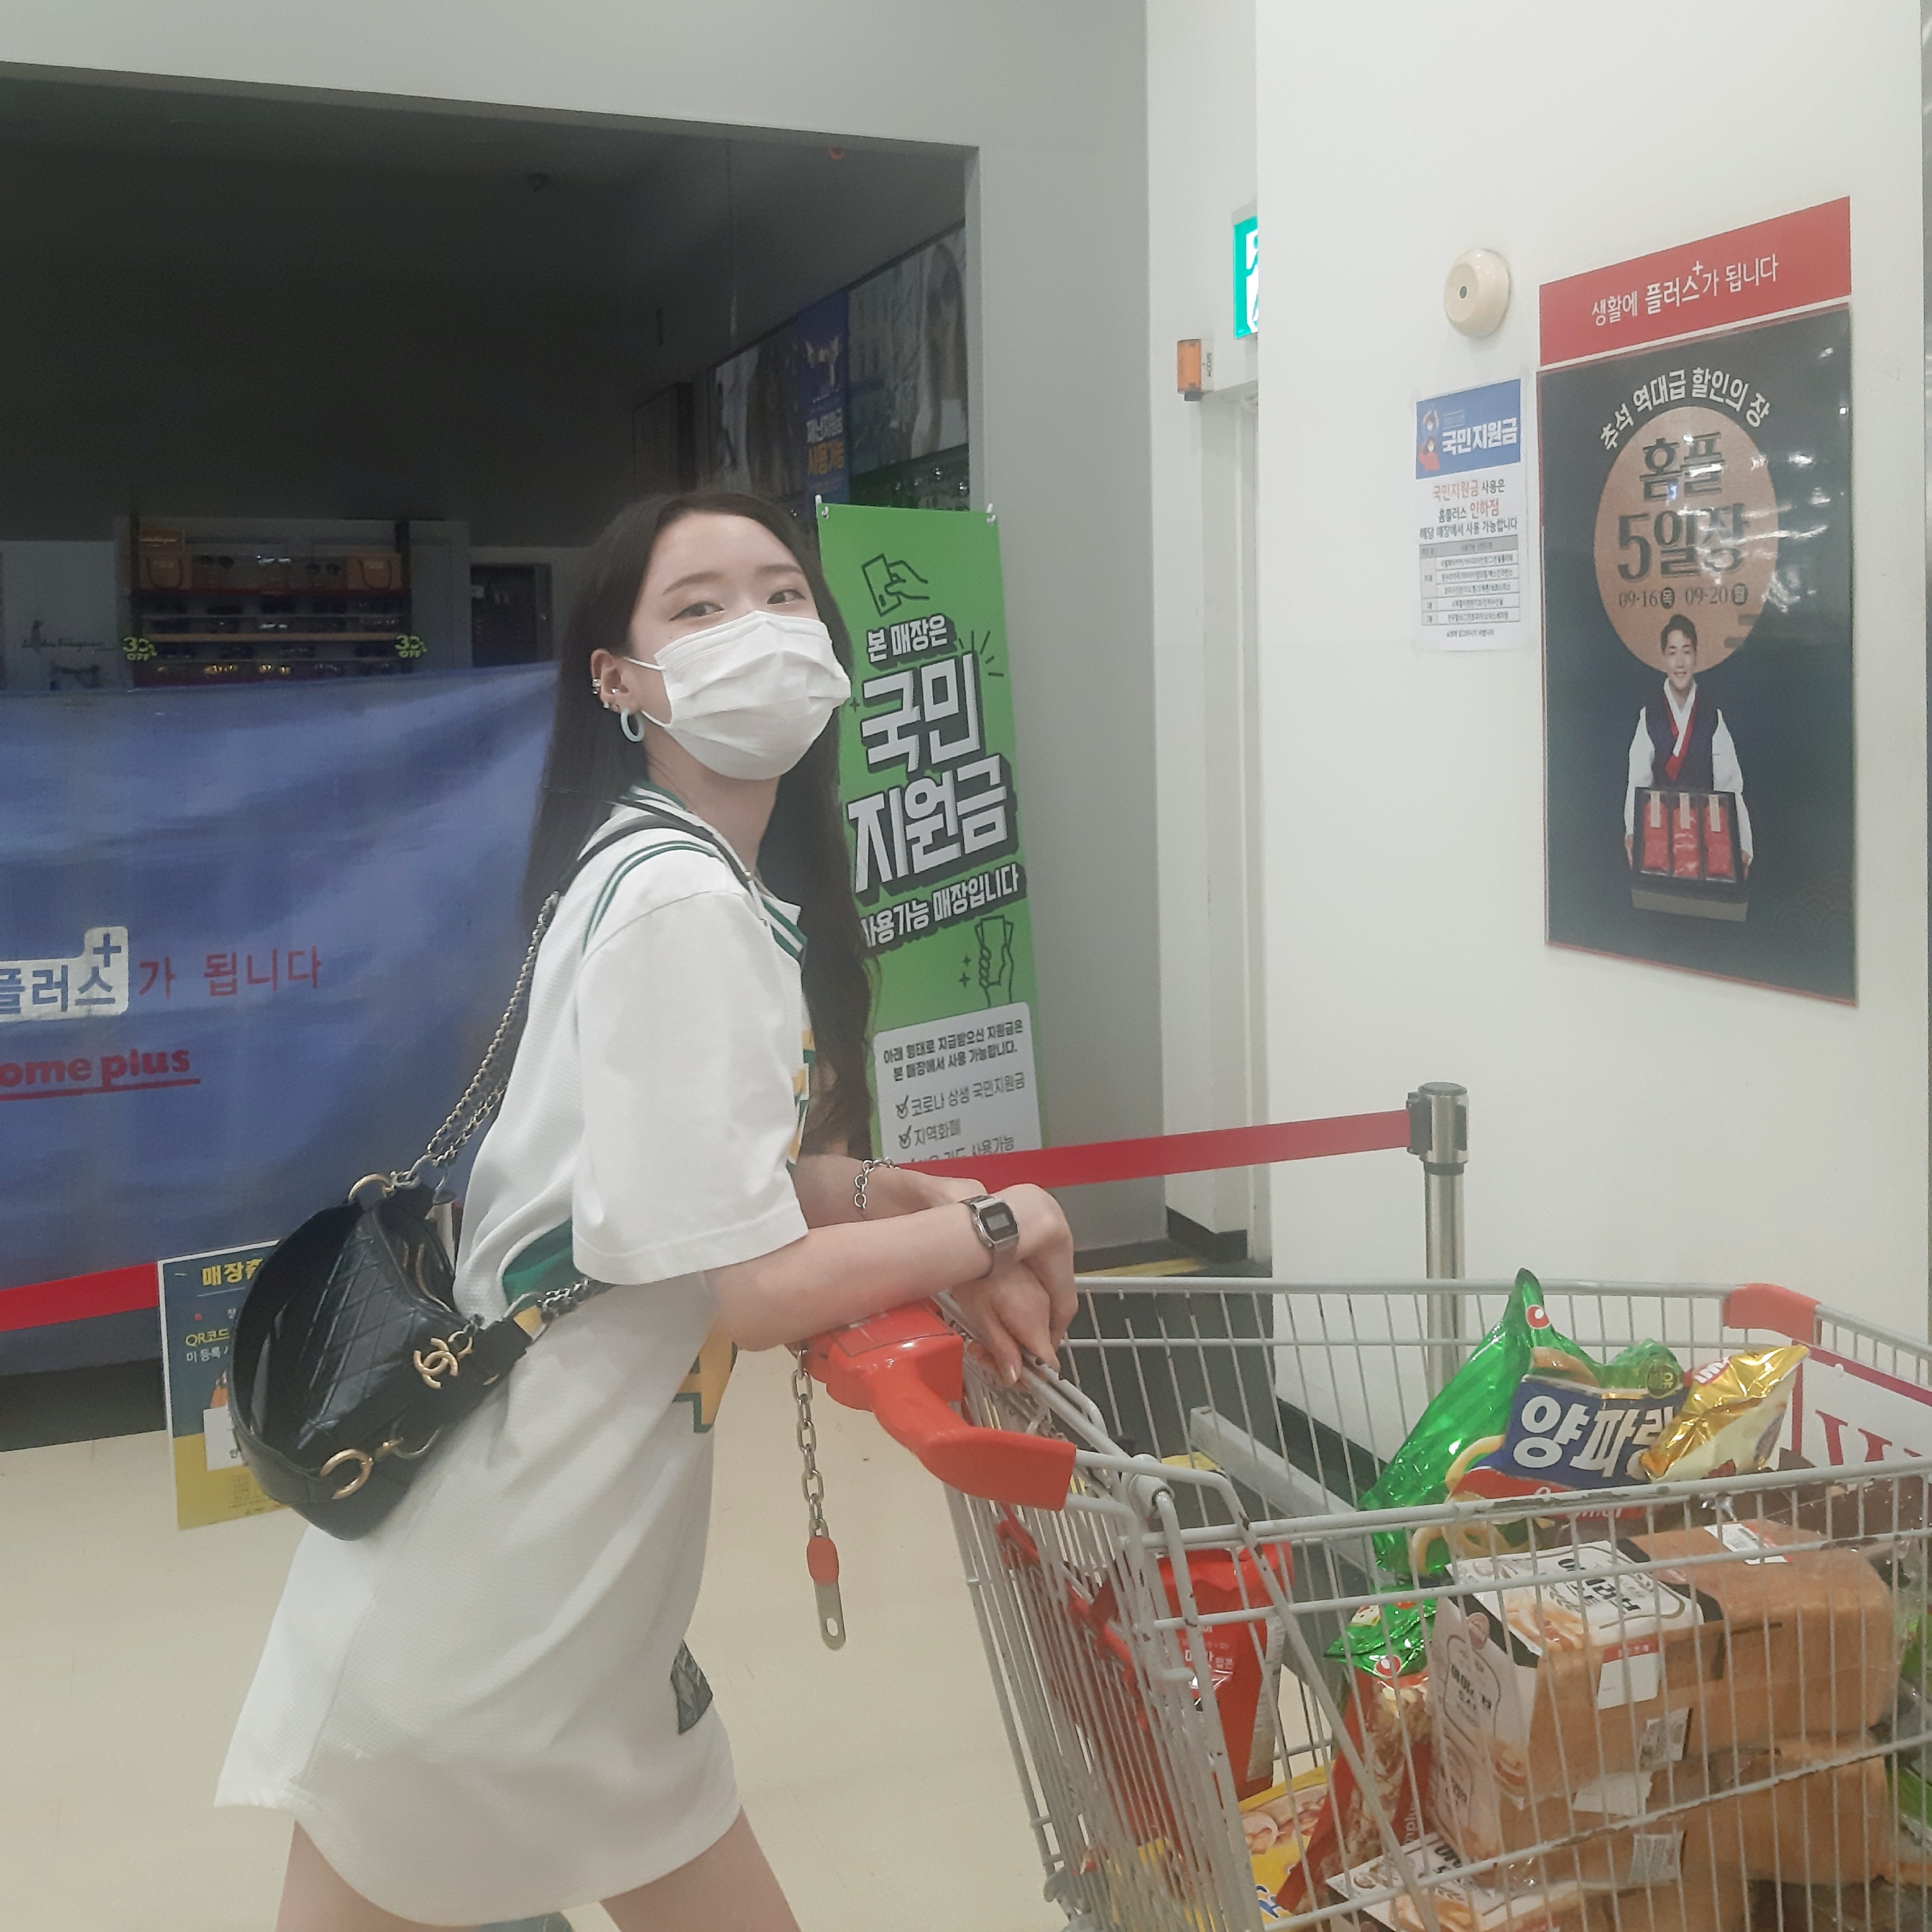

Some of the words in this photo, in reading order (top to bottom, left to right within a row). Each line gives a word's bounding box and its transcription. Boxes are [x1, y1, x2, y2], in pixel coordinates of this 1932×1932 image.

[1592, 289, 1638, 326] 생활에
[1724, 253, 1779, 293] 됩니다
[1600, 402, 1635, 450] 추석
[1633, 370, 1686, 413] 역대급
[1691, 367, 1750, 412] 할인의
[1745, 392, 1772, 428] 장
[1441, 417, 1518, 456] 국민지원금
[1639, 431, 1726, 501] 홈플
[1433, 480, 1479, 502] 국민지원금
[1481, 479, 1505, 494] 사용은
[1470, 497, 1499, 519] 인하점
[1465, 522, 1480, 535] 사용
[1482, 518, 1518, 534] 가능합니다
[867, 629, 887, 663] 본
[890, 614, 948, 657] 매장은
[861, 652, 981, 774] 국민
[847, 754, 1008, 894] 지원금
[860, 899, 930, 948] 사용가능
[932, 863, 1019, 922] 매장입니다
[203, 945, 322, 997] 됩니다
[884, 1046, 904, 1064] 아래
[906, 1040, 935, 1059] 형태로
[938, 1028, 984, 1051] 지급받으신
[987, 1019, 1024, 1040] 지원금은
[0, 1055, 92, 1087] ome
[101, 1048, 191, 1089] plus
[893, 1067, 904, 1082] 본
[906, 1058, 945, 1079] 매장에서
[948, 1053, 967, 1069] 사용
[911, 1094, 945, 1117] 코로나
[948, 1086, 970, 1107] 상생
[972, 1072, 1026, 1098] 국민지원금
[914, 1118, 962, 1146] 지역화폐
[185, 1328, 230, 1347] QR코드
